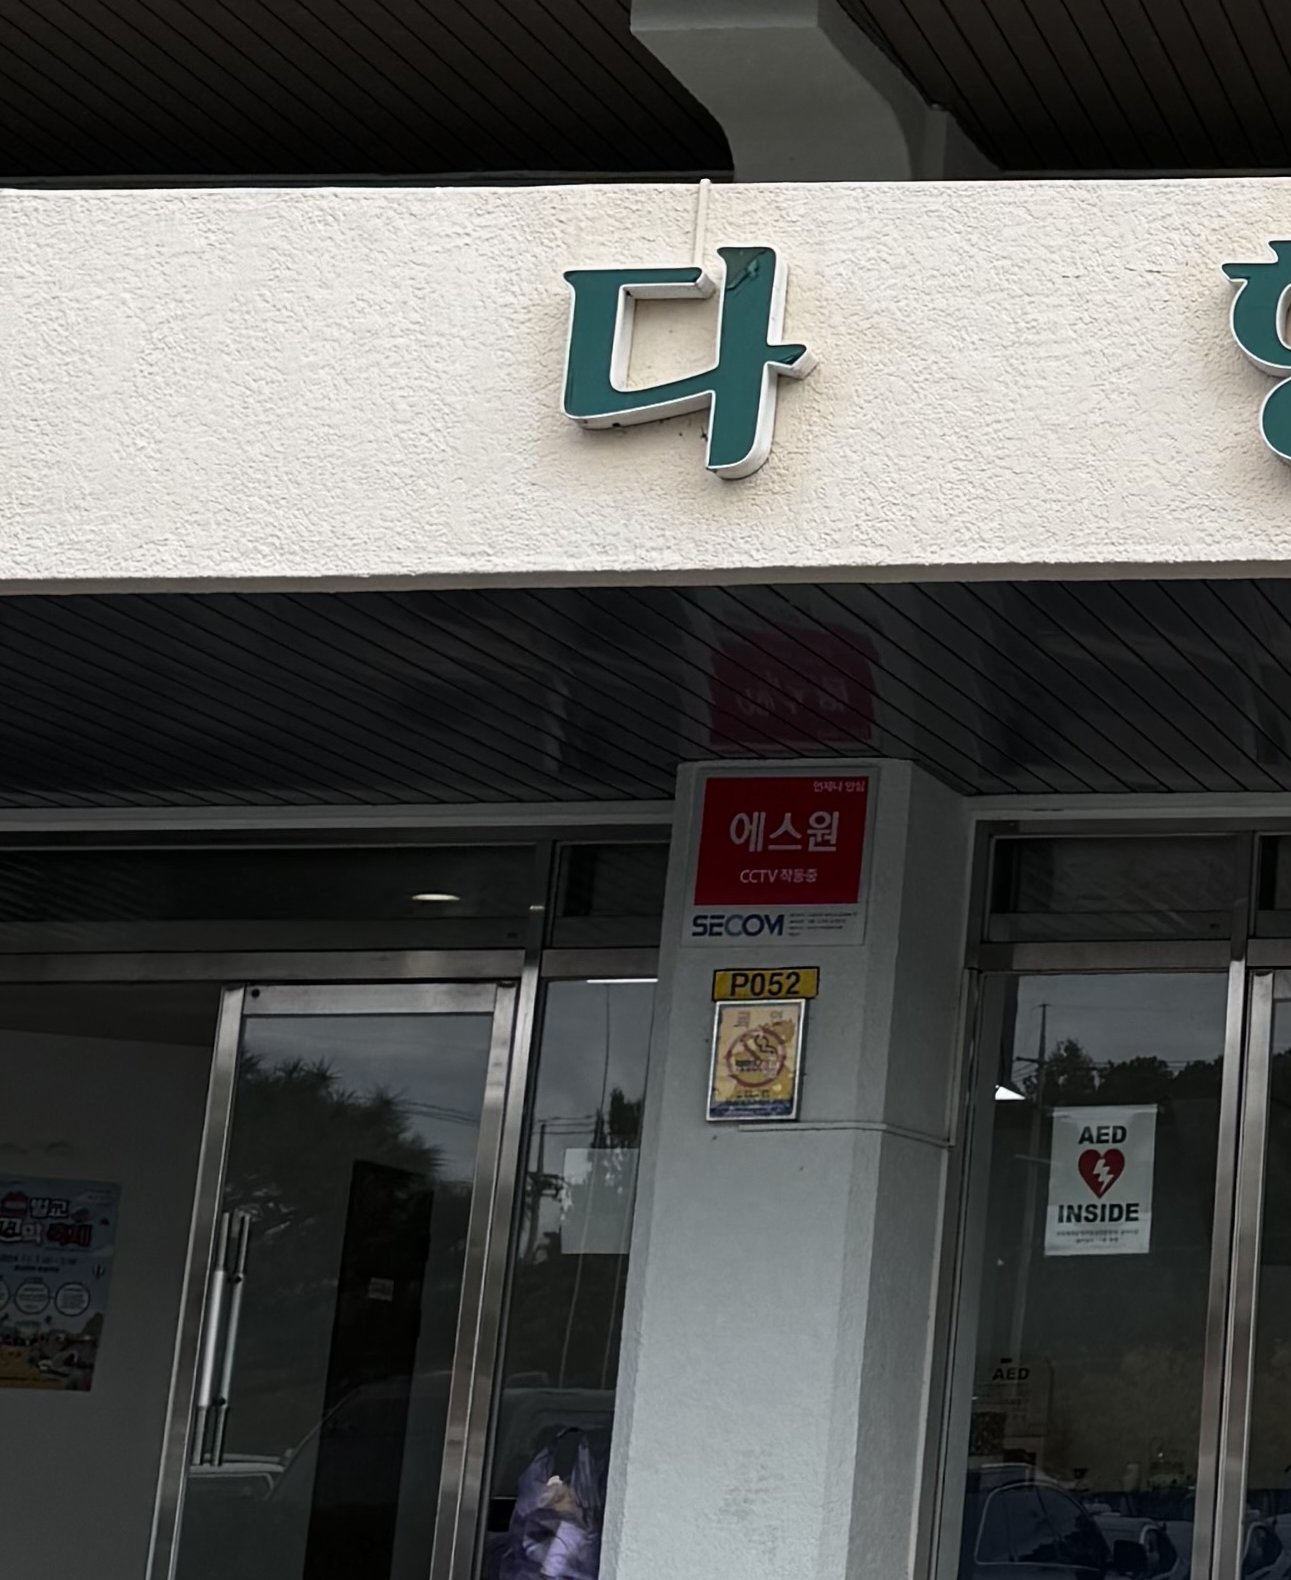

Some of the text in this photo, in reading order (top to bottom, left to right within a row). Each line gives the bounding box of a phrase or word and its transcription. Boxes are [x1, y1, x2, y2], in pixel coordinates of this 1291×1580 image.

[729, 810, 840, 853] 에스원
[739, 868, 778, 883] CCTV
[691, 913, 785, 937] SECOM
[730, 971, 801, 997] P052
[1077, 1125, 1128, 1145] AED
[1057, 1203, 1140, 1224] INSIDE
[991, 1367, 1030, 1381] AED
